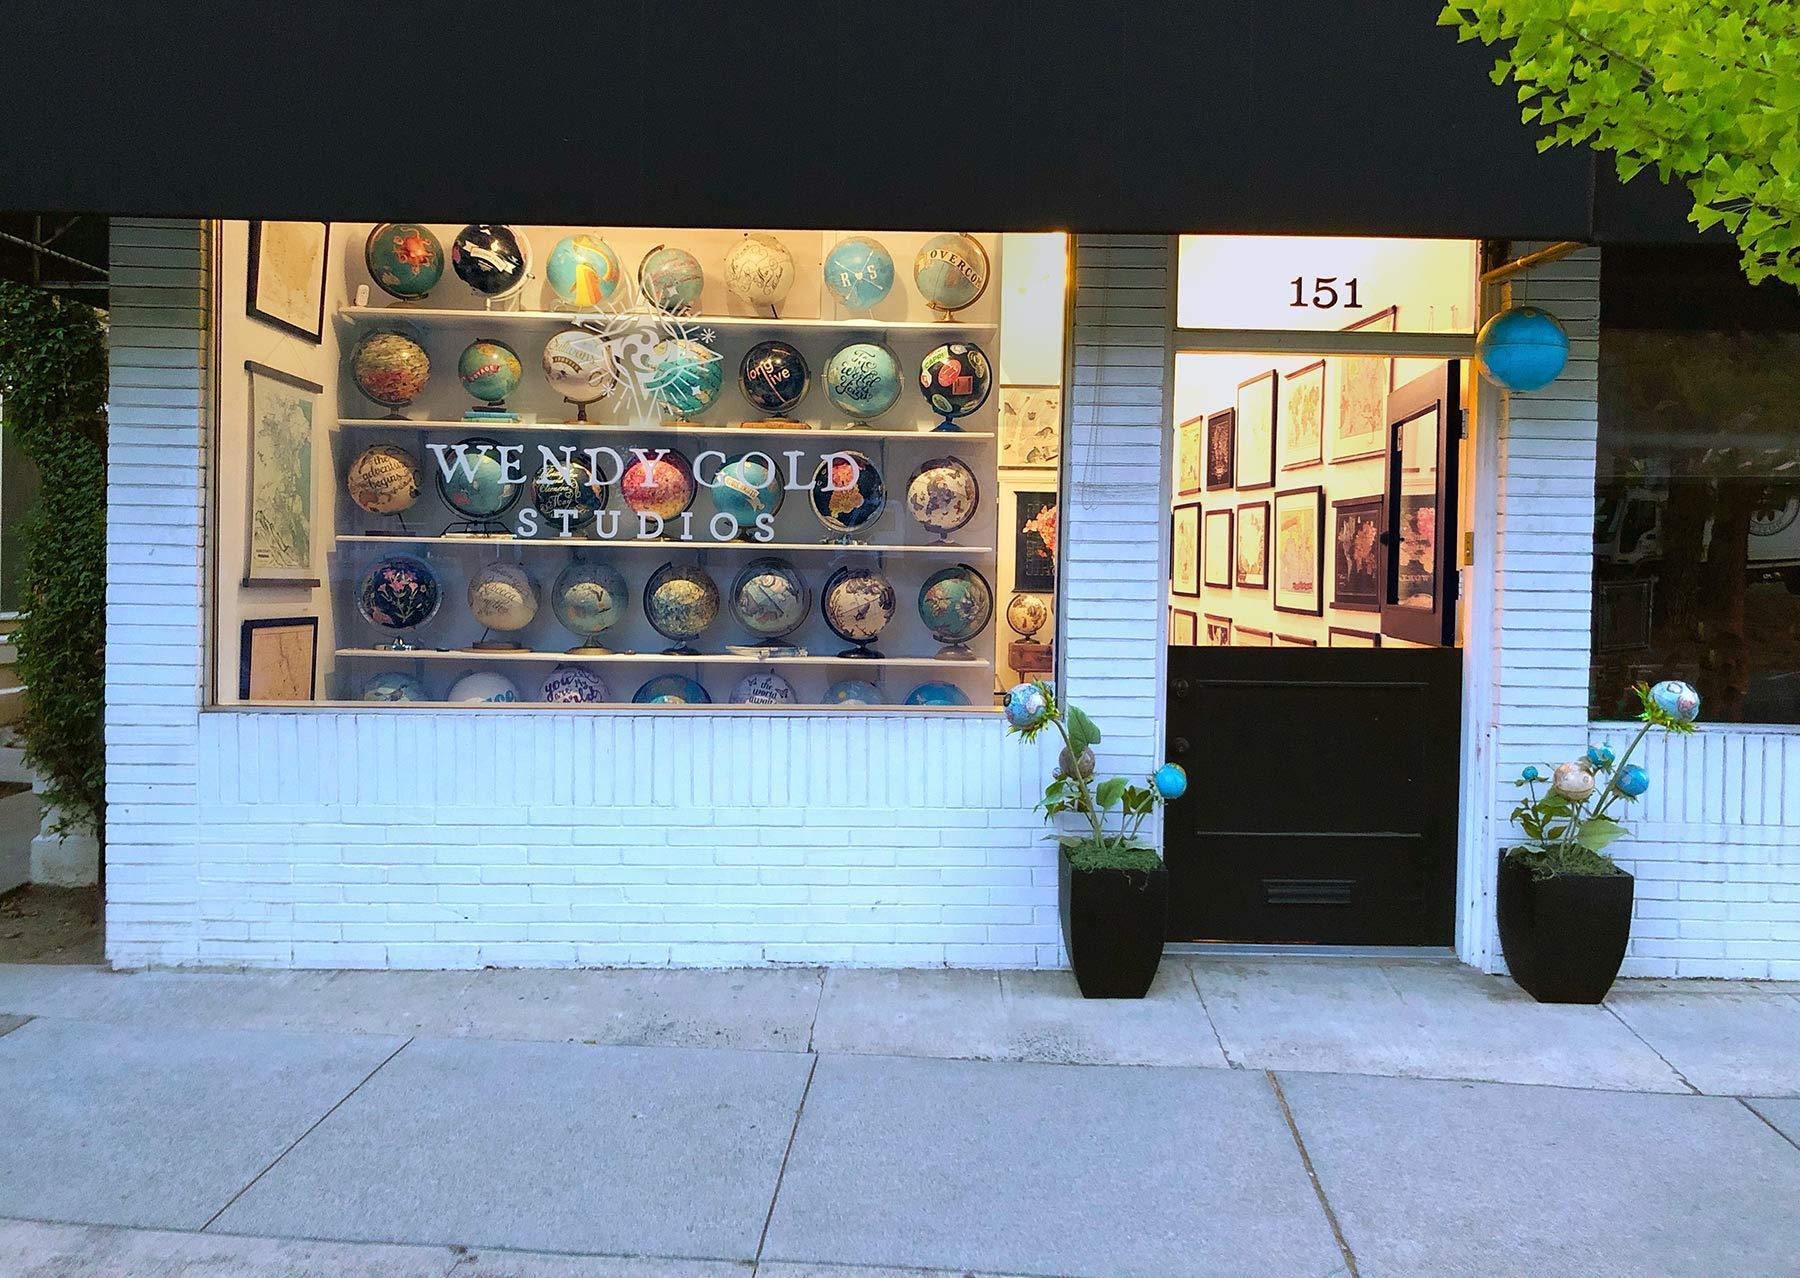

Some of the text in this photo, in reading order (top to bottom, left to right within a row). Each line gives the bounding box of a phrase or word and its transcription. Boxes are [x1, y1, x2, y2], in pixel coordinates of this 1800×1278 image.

[1289, 276, 1363, 309] 151
[425, 443, 671, 489] WENDY
[692, 449, 861, 493] GOLD
[517, 508, 776, 543] STUDIOS
